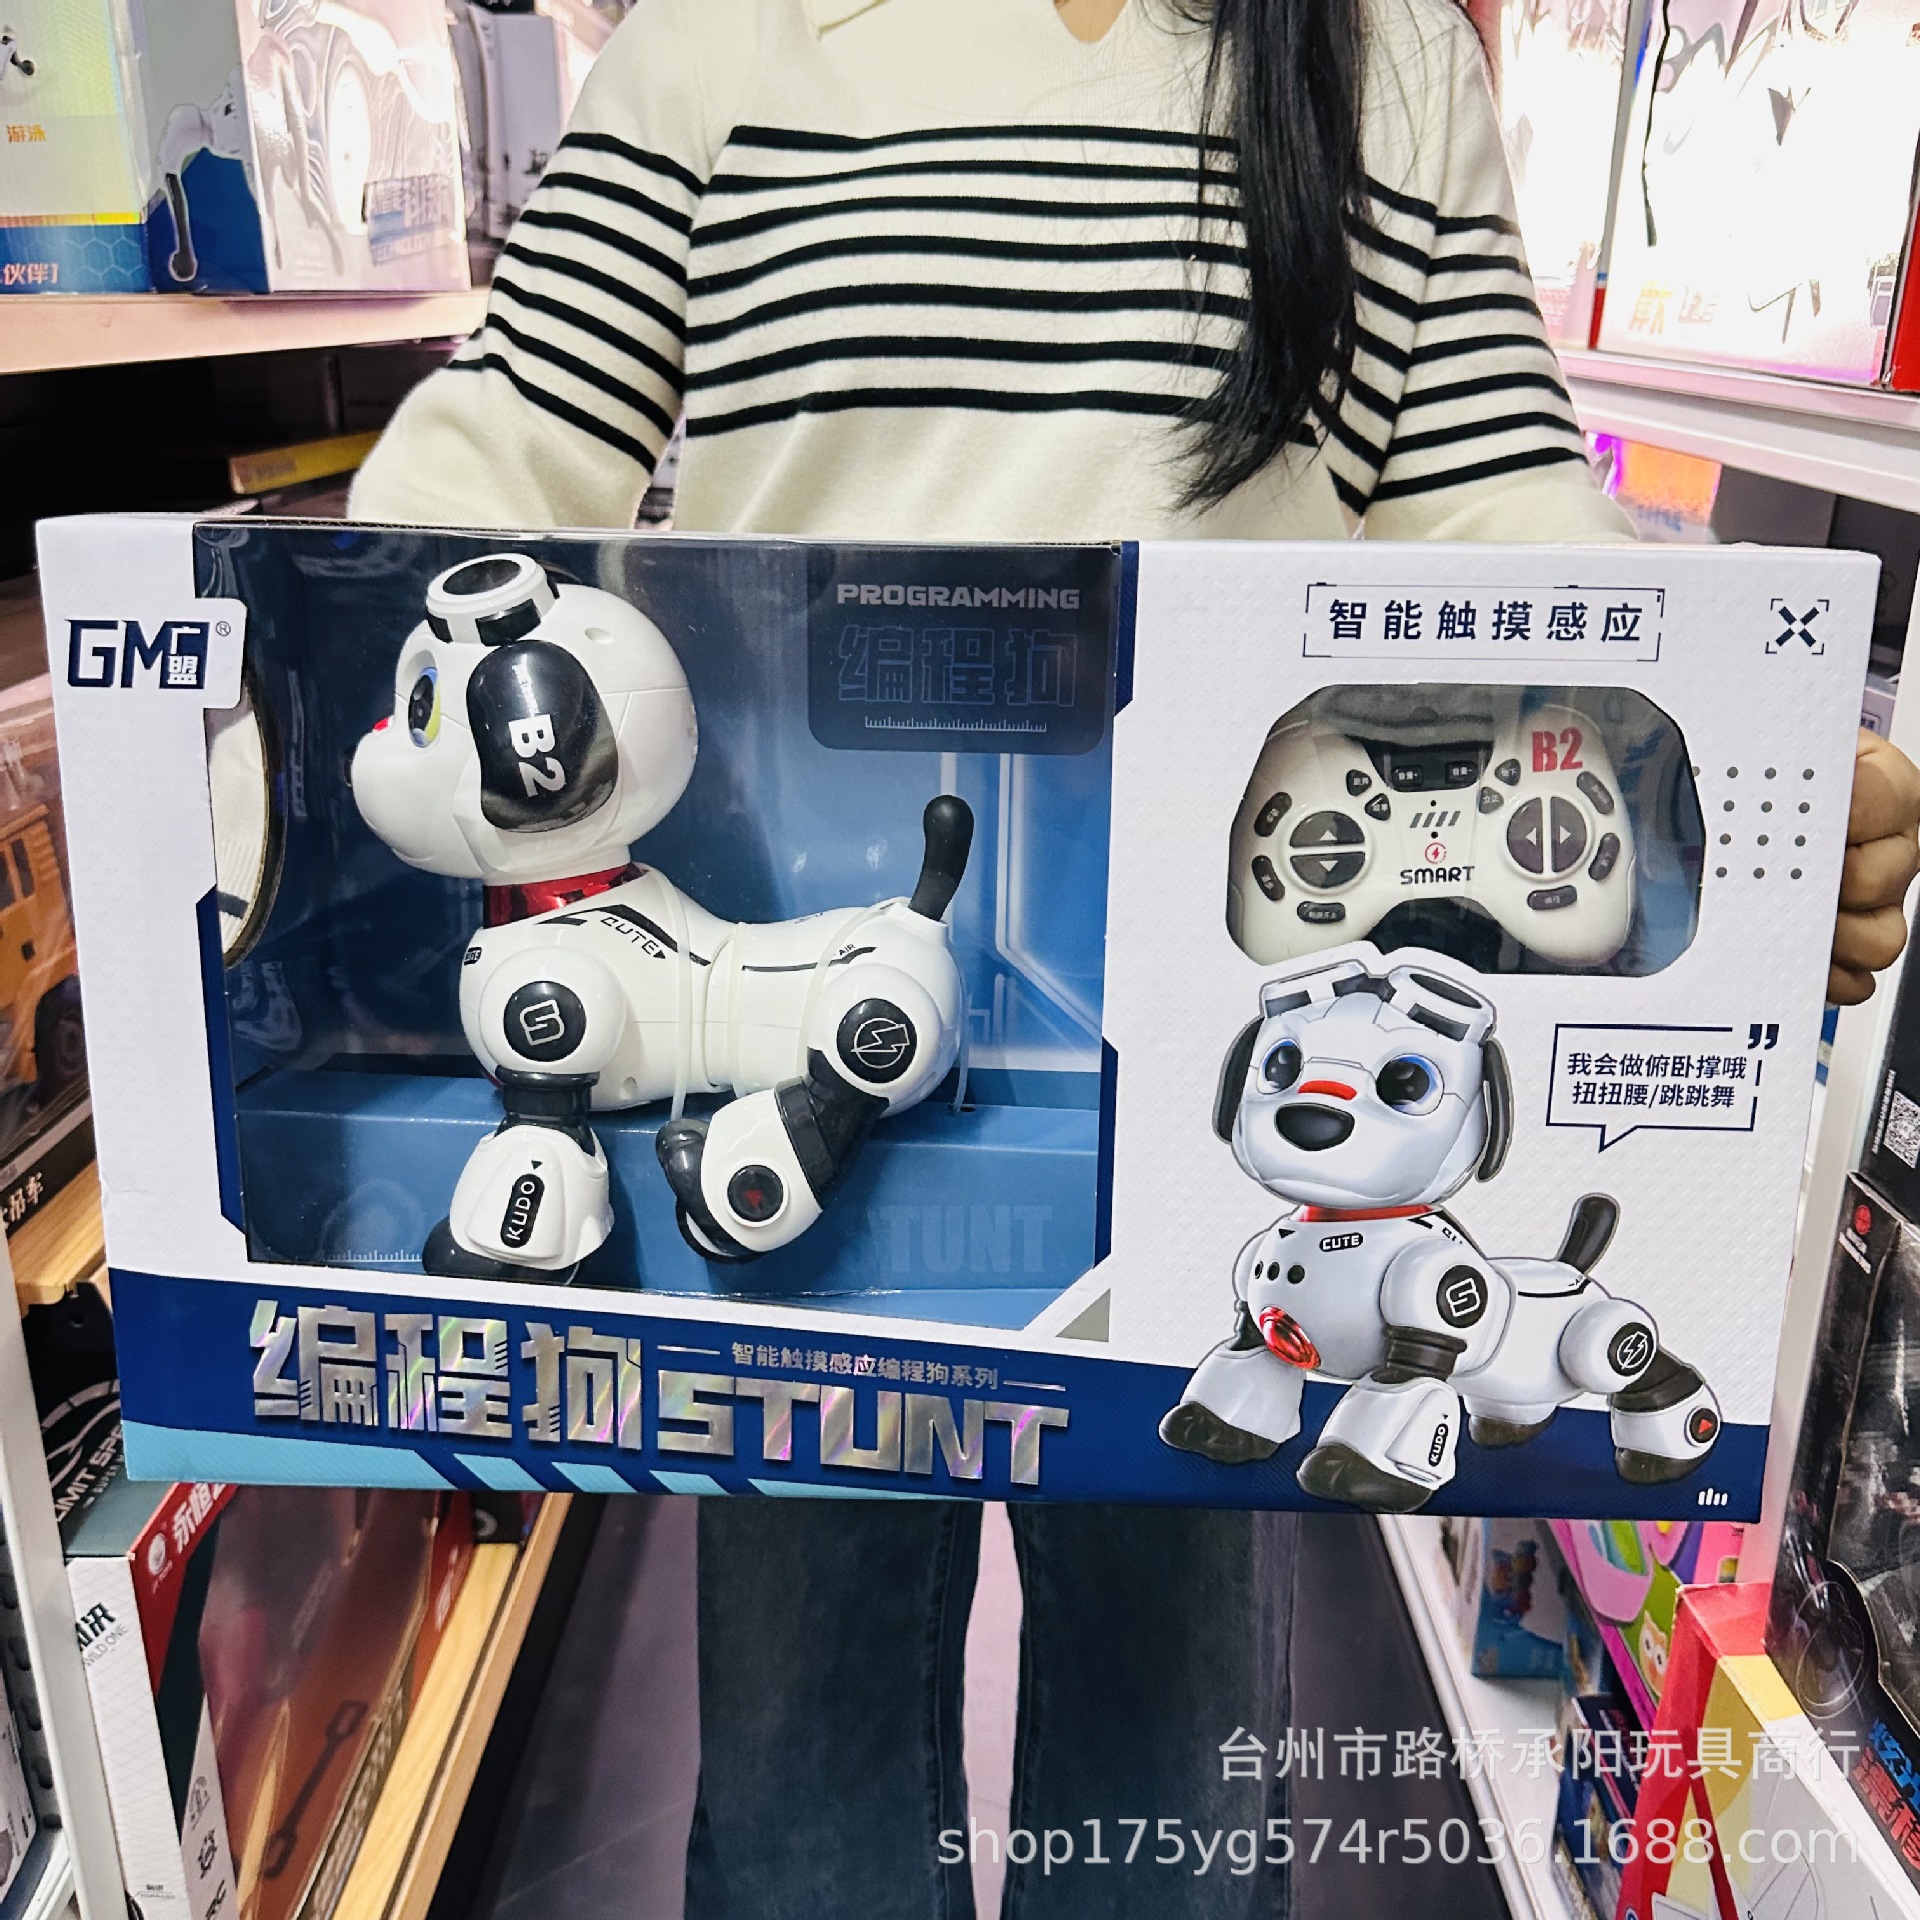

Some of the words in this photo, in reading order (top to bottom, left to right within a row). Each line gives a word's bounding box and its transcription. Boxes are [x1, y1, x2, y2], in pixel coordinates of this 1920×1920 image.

[7, 124, 47, 143] 游泳
[836, 583, 1080, 610] PROGRAMMING
[1329, 598, 1643, 643] 智能触摸感应
[838, 624, 1078, 708] 编程狗
[508, 713, 567, 798] B2
[1532, 727, 1584, 773] B2
[1399, 865, 1476, 885] SMART
[600, 916, 659, 955] CUTE
[1567, 1052, 1748, 1080] 我会做俯卧撑哦
[1572, 1081, 1736, 1109] 扭扭腰/跳跳舞
[505, 1180, 536, 1241] KUDO
[1321, 1233, 1361, 1251] CUTE
[249, 1299, 643, 1451] 编程狗
[731, 1340, 999, 1391] 智能触摸感应编程狗系列
[656, 1368, 1070, 1486] STUNT
[1430, 1425, 1448, 1464] KUDO
[172, 1483, 227, 1554] 永恒
